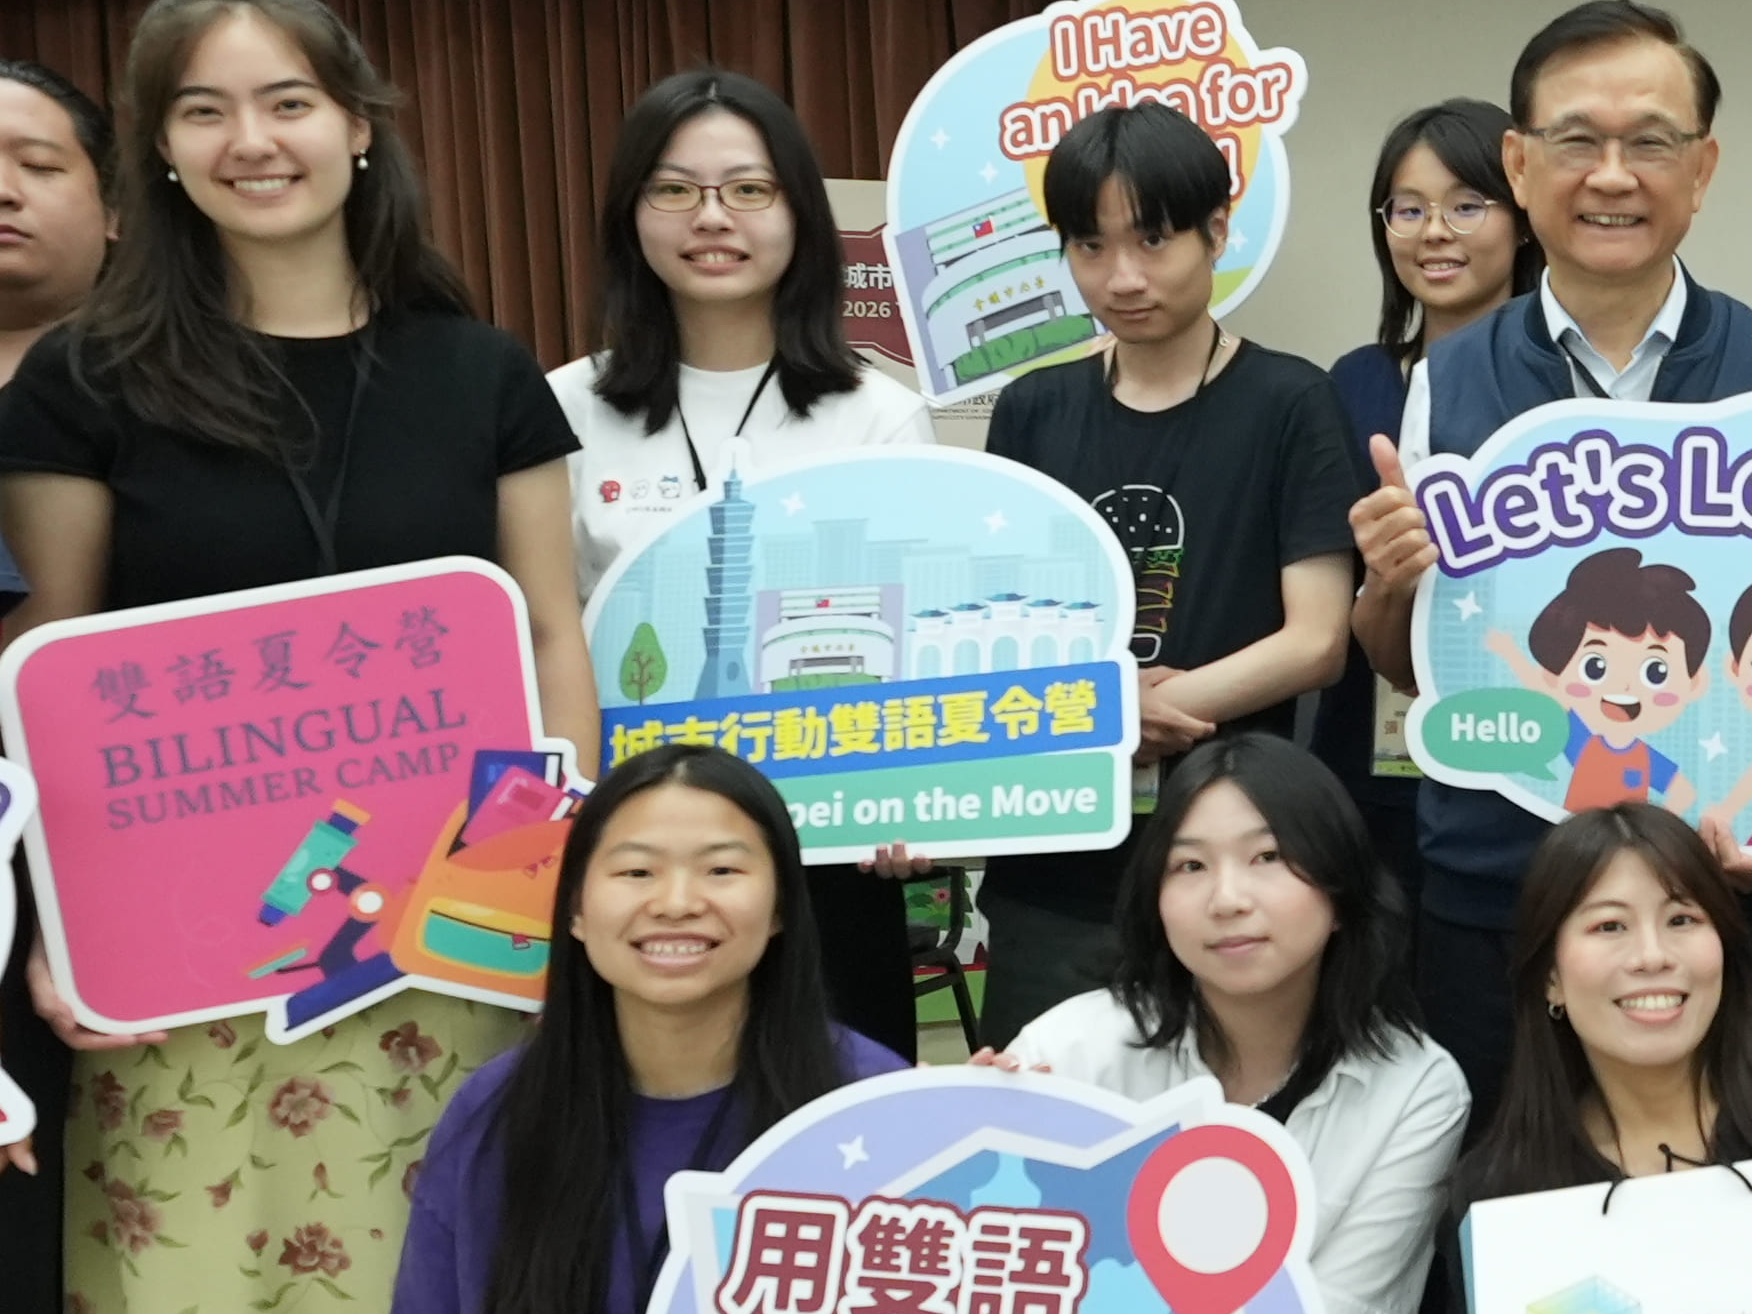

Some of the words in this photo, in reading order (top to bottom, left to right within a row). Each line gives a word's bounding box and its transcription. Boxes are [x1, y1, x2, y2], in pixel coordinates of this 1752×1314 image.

[1054, 20, 1079, 78] I
[1083, 5, 1224, 73] Have
[1002, 102, 1074, 157] an
[1202, 61, 1292, 127] for
[843, 300, 892, 318] 2026
[1423, 431, 1665, 574] Let's
[90, 605, 450, 724] 雙語夏令營
[100, 688, 467, 789] BILINGUAL
[1450, 711, 1543, 744] Hello
[106, 767, 324, 831] SUMMER
[337, 742, 462, 803] CAMP
[853, 796, 906, 825] on
[914, 789, 982, 820] the
[991, 785, 1099, 818] Move
